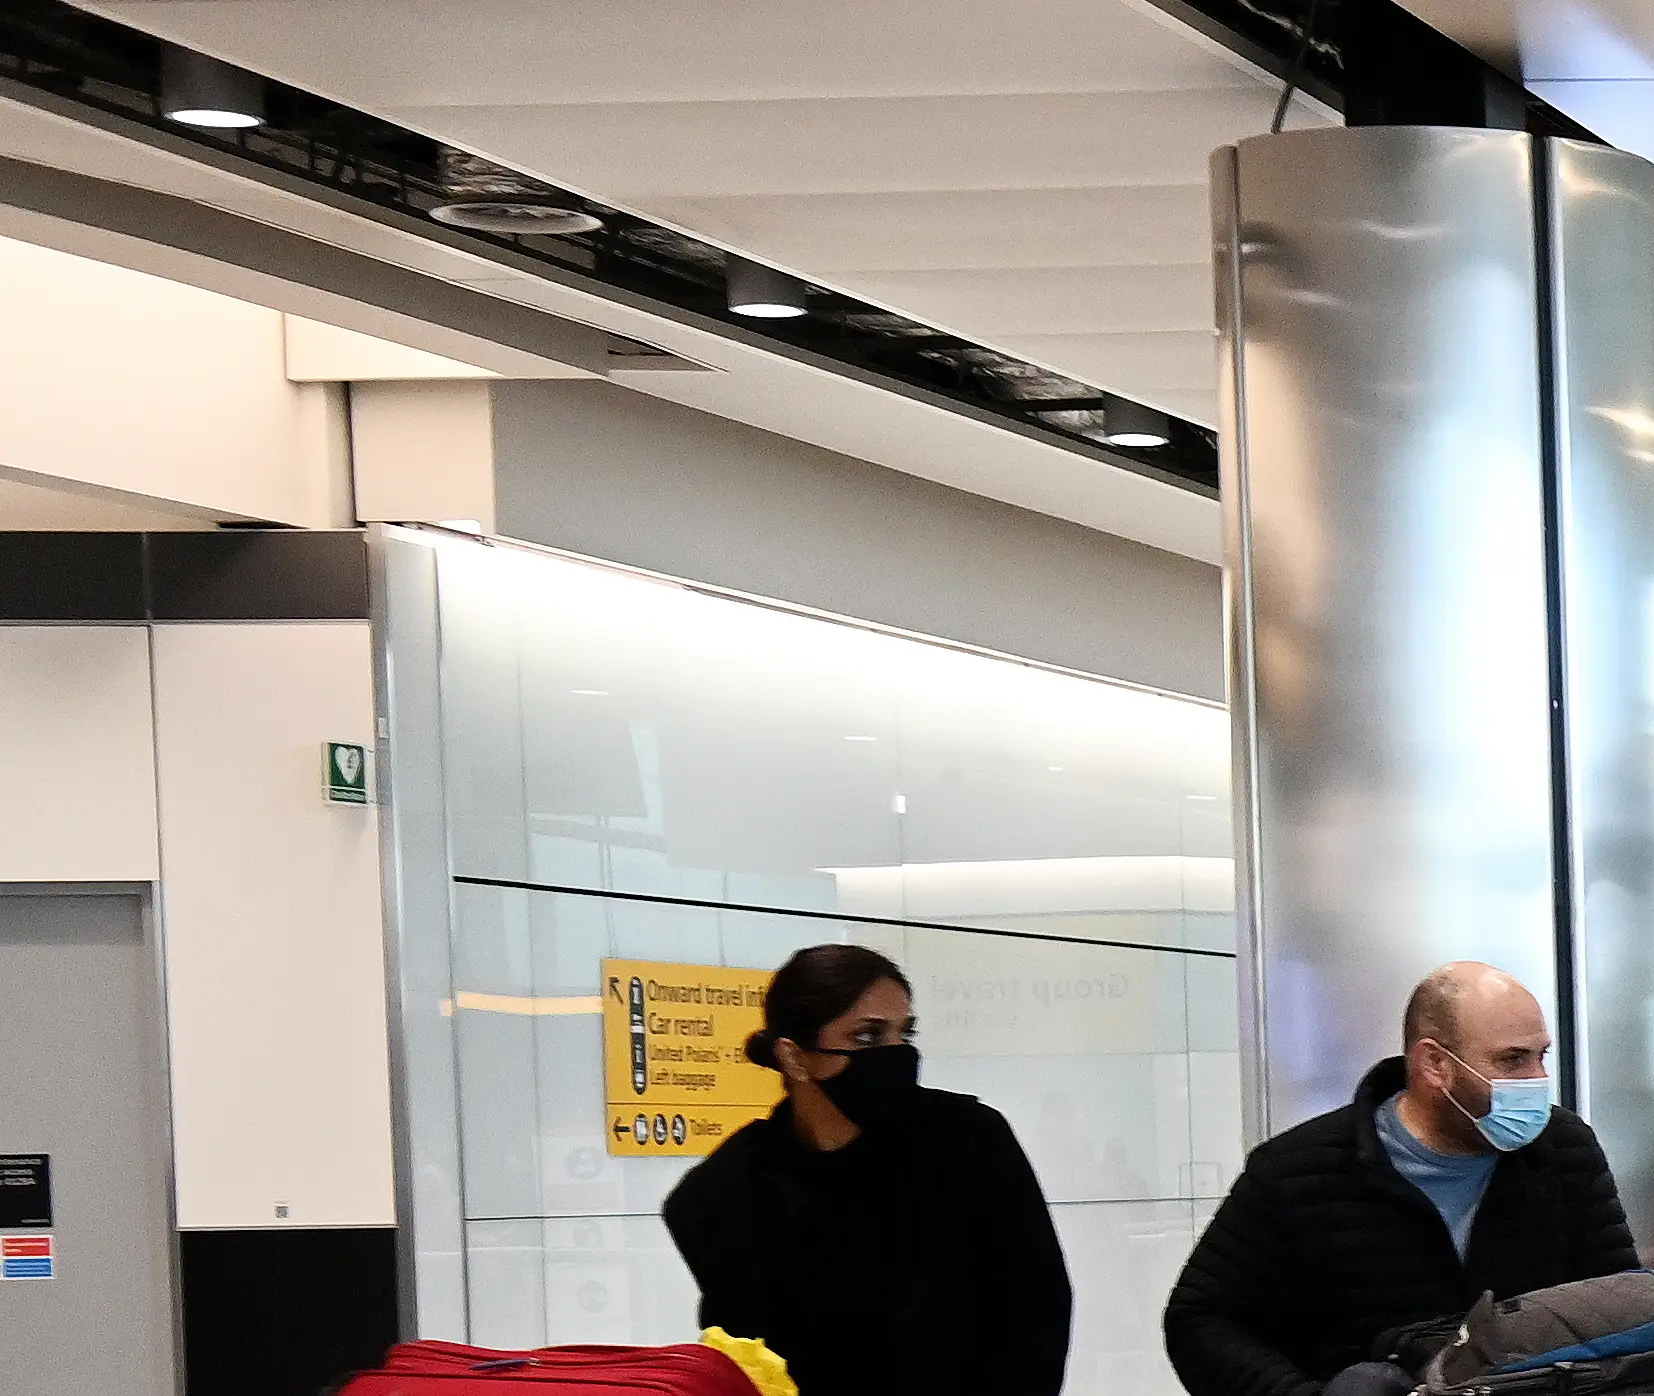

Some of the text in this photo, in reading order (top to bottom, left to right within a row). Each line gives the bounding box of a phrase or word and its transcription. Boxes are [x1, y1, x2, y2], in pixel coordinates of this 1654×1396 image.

[648, 979, 702, 1003] Onward
[705, 984, 744, 1007] travel
[649, 1012, 715, 1037] Car rental
[689, 1117, 723, 1137] Toilets
